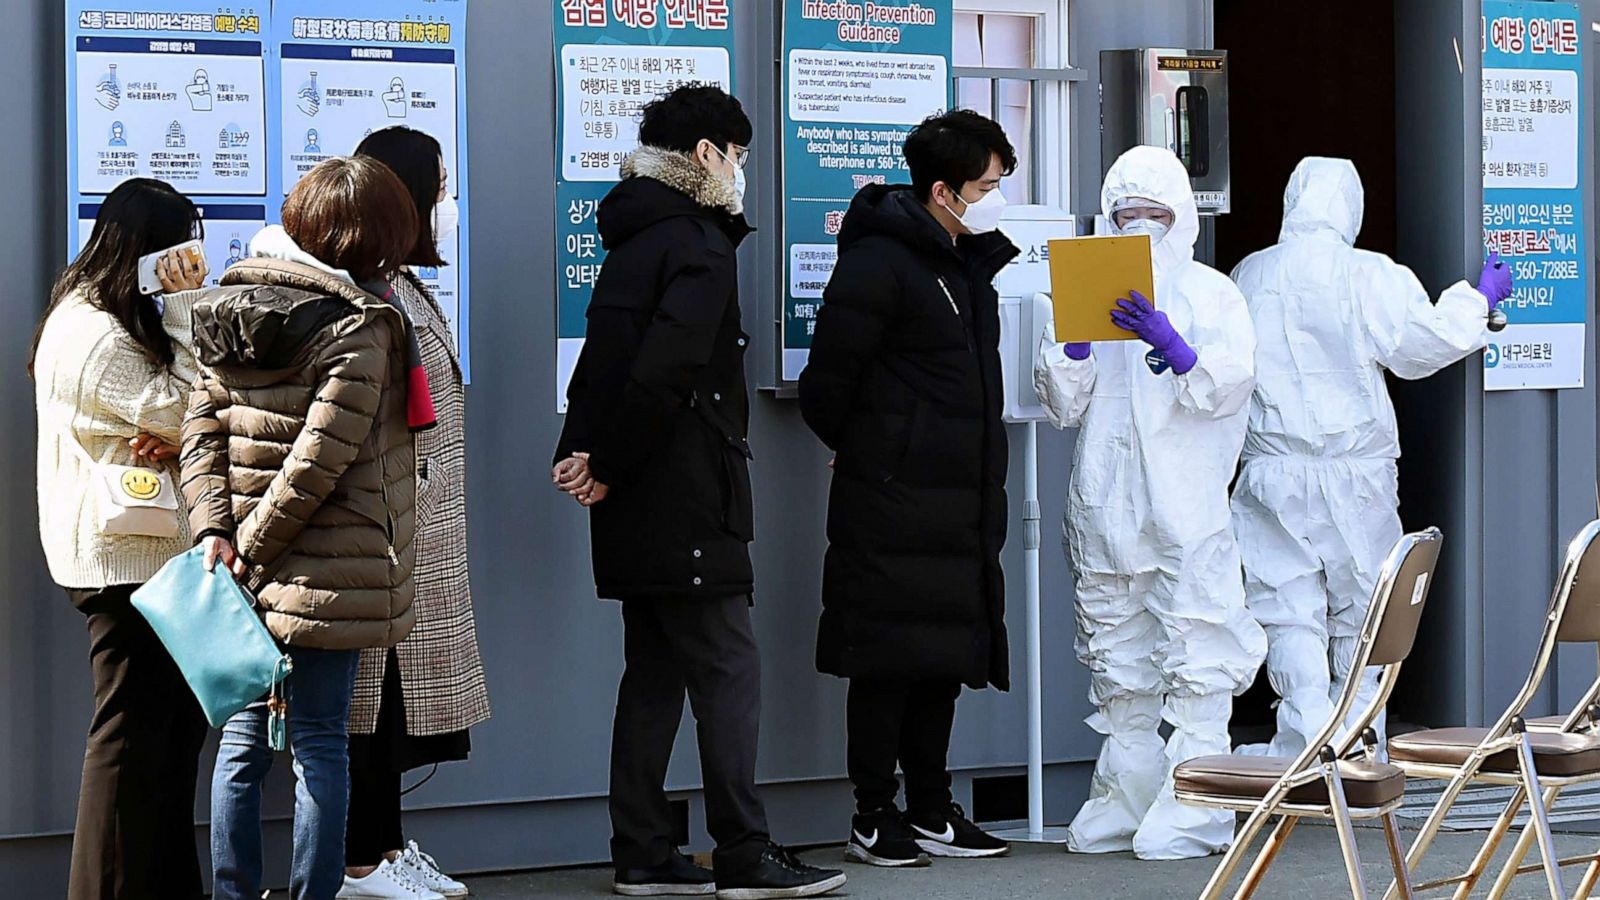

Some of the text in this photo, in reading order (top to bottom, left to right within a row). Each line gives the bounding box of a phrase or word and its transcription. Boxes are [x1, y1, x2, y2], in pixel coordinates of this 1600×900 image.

[561, 0, 728, 29] 감염 예방 안내문
[803, 0, 936, 25] Infection Prevention
[79, 11, 259, 34] 신종 코로나바이러스감염증 예방 수칙
[838, 23, 899, 43] Guidance
[1491, 17, 1524, 54] 예방
[1528, 18, 1579, 55] 안내문
[578, 56, 696, 75] 최근 2주 이내 해외 거주 및
[580, 78, 619, 95] 여행자로
[621, 79, 641, 95] 발열
[644, 80, 663, 95] 또는
[1495, 80, 1510, 93] 이내
[1512, 80, 1527, 94] 해외
[1528, 80, 1543, 94] 거주
[580, 100, 605, 118] (기침,
[1495, 98, 1511, 112] 발열
[1512, 99, 1528, 113] 또는
[1529, 98, 1571, 114] 호흡기증상자
[583, 121, 619, 140] 인후통)
[797, 126, 833, 141] Anybody
[836, 129, 853, 141] who
[854, 128, 870, 141] has
[807, 141, 902, 156] described is allowed to
[580, 152, 610, 169] 감염병
[820, 154, 865, 170] interphone
[866, 159, 875, 168] or
[1489, 162, 1504, 177] 의심
[1506, 162, 1521, 177] 환자
[1483, 205, 1574, 225] 증상이 있으신 분은
[566, 234, 597, 258] 이곳
[1516, 261, 1579, 280] 560-7288로
[1503, 343, 1552, 361] 대구의료원
